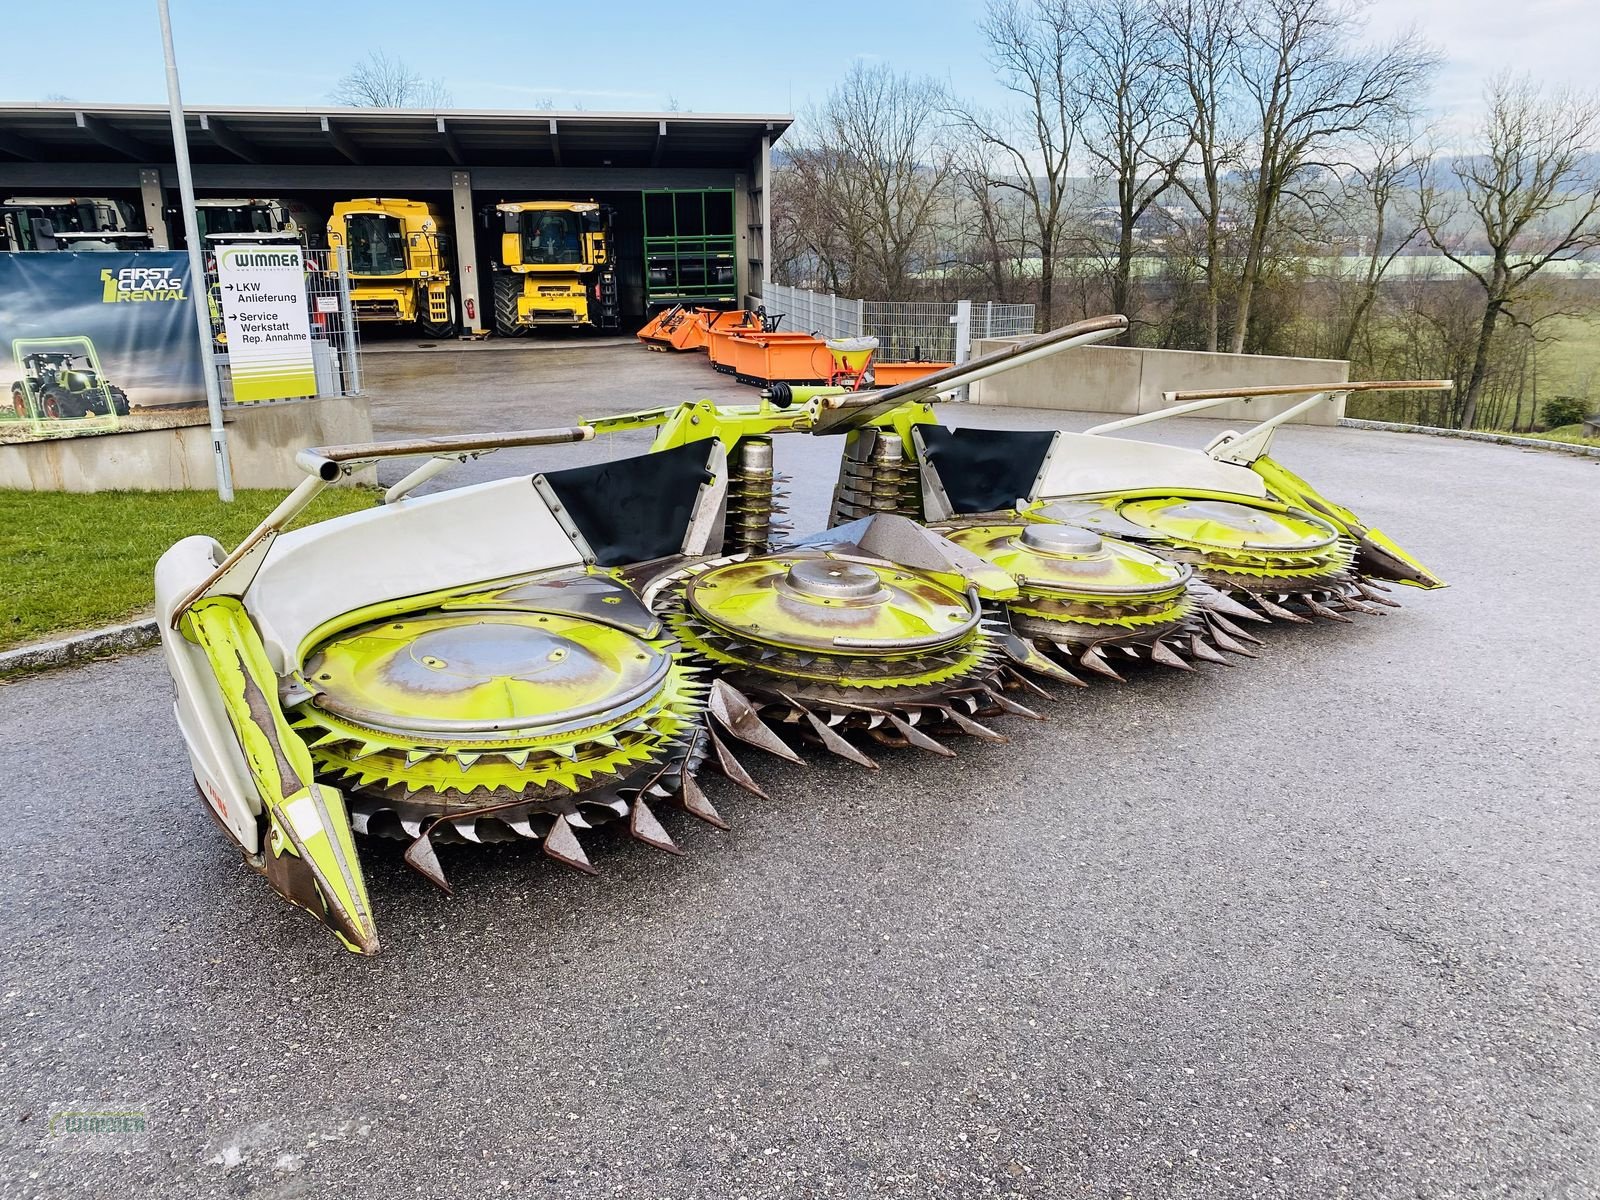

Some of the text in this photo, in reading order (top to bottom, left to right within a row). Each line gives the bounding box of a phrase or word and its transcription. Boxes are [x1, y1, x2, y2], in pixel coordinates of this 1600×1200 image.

[235, 254, 299, 267] WIMMER
[118, 268, 173, 280] FIRST
[118, 278, 182, 291] CLAAS
[236, 282, 261, 291] LKW
[116, 289, 188, 302] RENTAL
[238, 293, 297, 303] Anlieferung
[239, 312, 278, 321] Service
[241, 323, 290, 332] Werkstatt
[242, 332, 307, 344] Rep. Annahme
